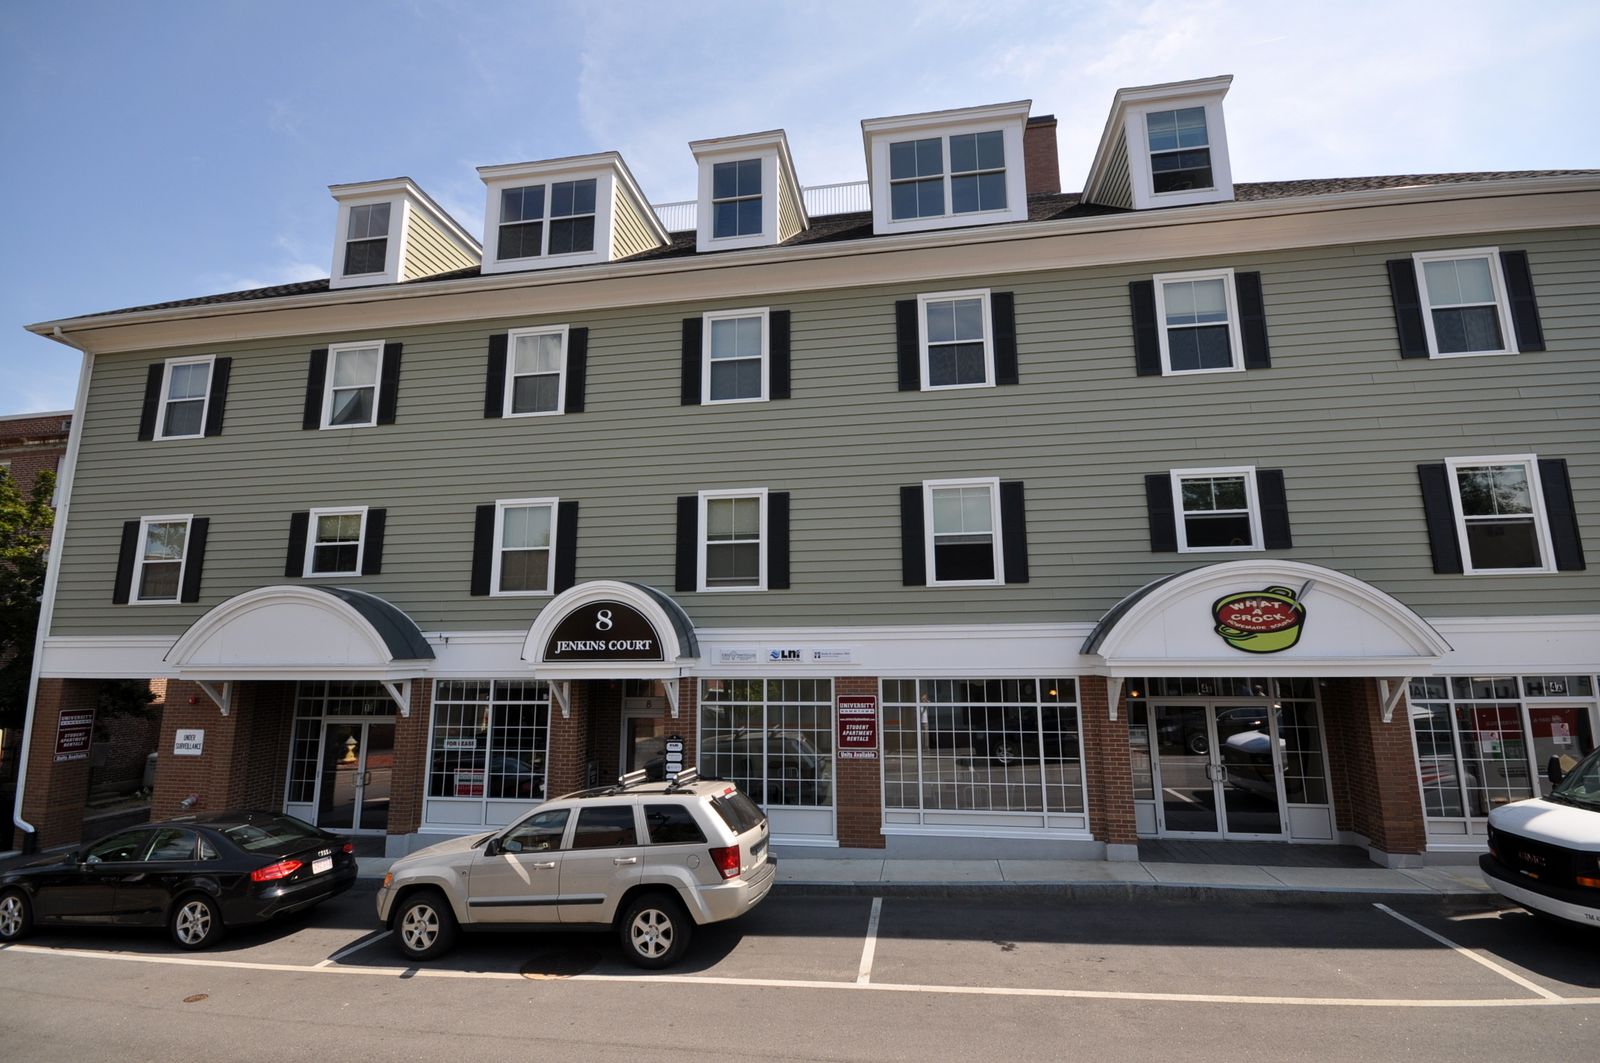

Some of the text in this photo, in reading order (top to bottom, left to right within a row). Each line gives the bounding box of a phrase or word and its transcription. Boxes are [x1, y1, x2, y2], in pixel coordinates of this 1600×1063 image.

[1229, 600, 1282, 610] WHAT
[595, 609, 613, 631] 8
[1230, 613, 1286, 623] CROCK
[555, 640, 653, 654] JENKINS COURT
